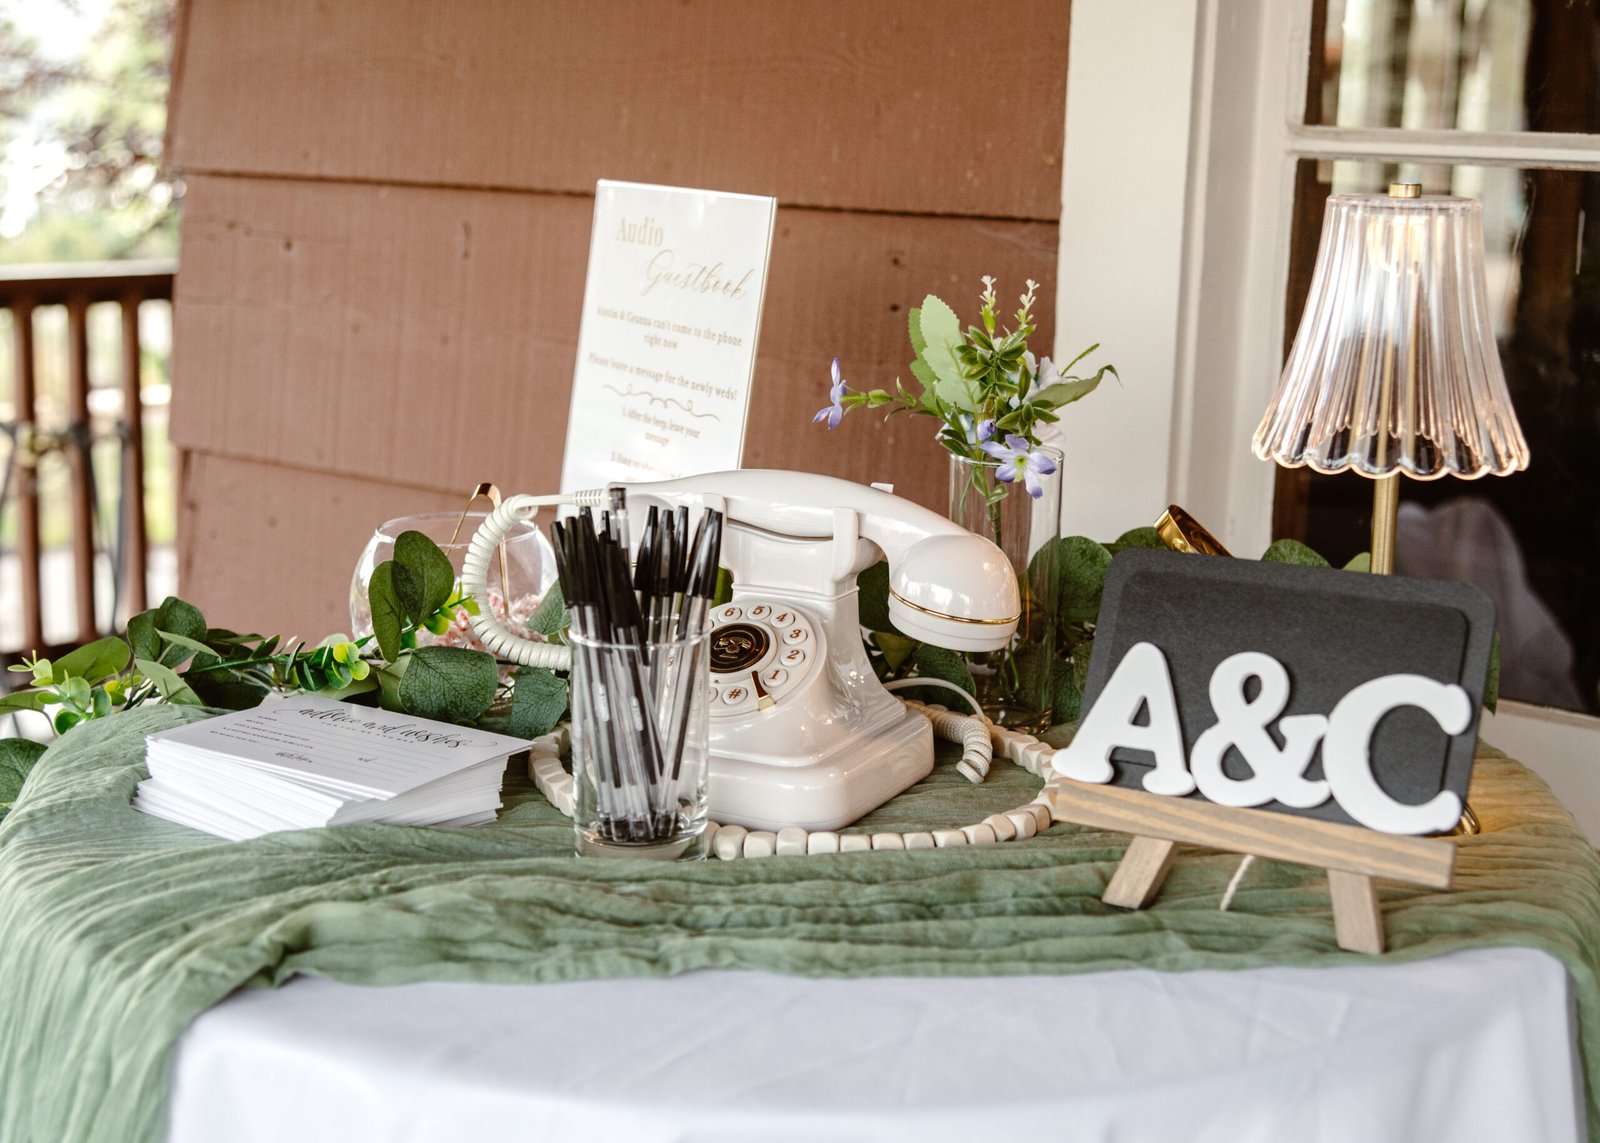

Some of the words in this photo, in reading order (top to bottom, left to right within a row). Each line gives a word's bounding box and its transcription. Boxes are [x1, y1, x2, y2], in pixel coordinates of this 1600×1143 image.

[615, 216, 664, 248] Audio
[641, 248, 755, 300] Guestbook
[653, 319, 671, 332] can't
[672, 323, 692, 335] come
[694, 327, 702, 338] to
[704, 328, 716, 341] the
[717, 331, 742, 347] phone
[643, 333, 662, 347] right
[662, 338, 679, 350] now
[589, 352, 610, 368] Please
[610, 356, 628, 373] leave
[634, 366, 664, 383] message
[664, 371, 676, 384] for
[677, 374, 689, 388] the
[690, 380, 714, 397] newly
[714, 386, 738, 400] weds!
[724, 608, 736, 616] 6
[753, 606, 765, 615] 5
[776, 612, 788, 622] 4
[790, 629, 802, 638] 3
[787, 650, 800, 660] 2
[769, 670, 780, 680] 1
[728, 688, 742, 699] #
[300, 708, 361, 723] advice
[362, 724, 416, 734] and
[400, 730, 472, 748] wishes
[1051, 641, 1471, 835] A&C
